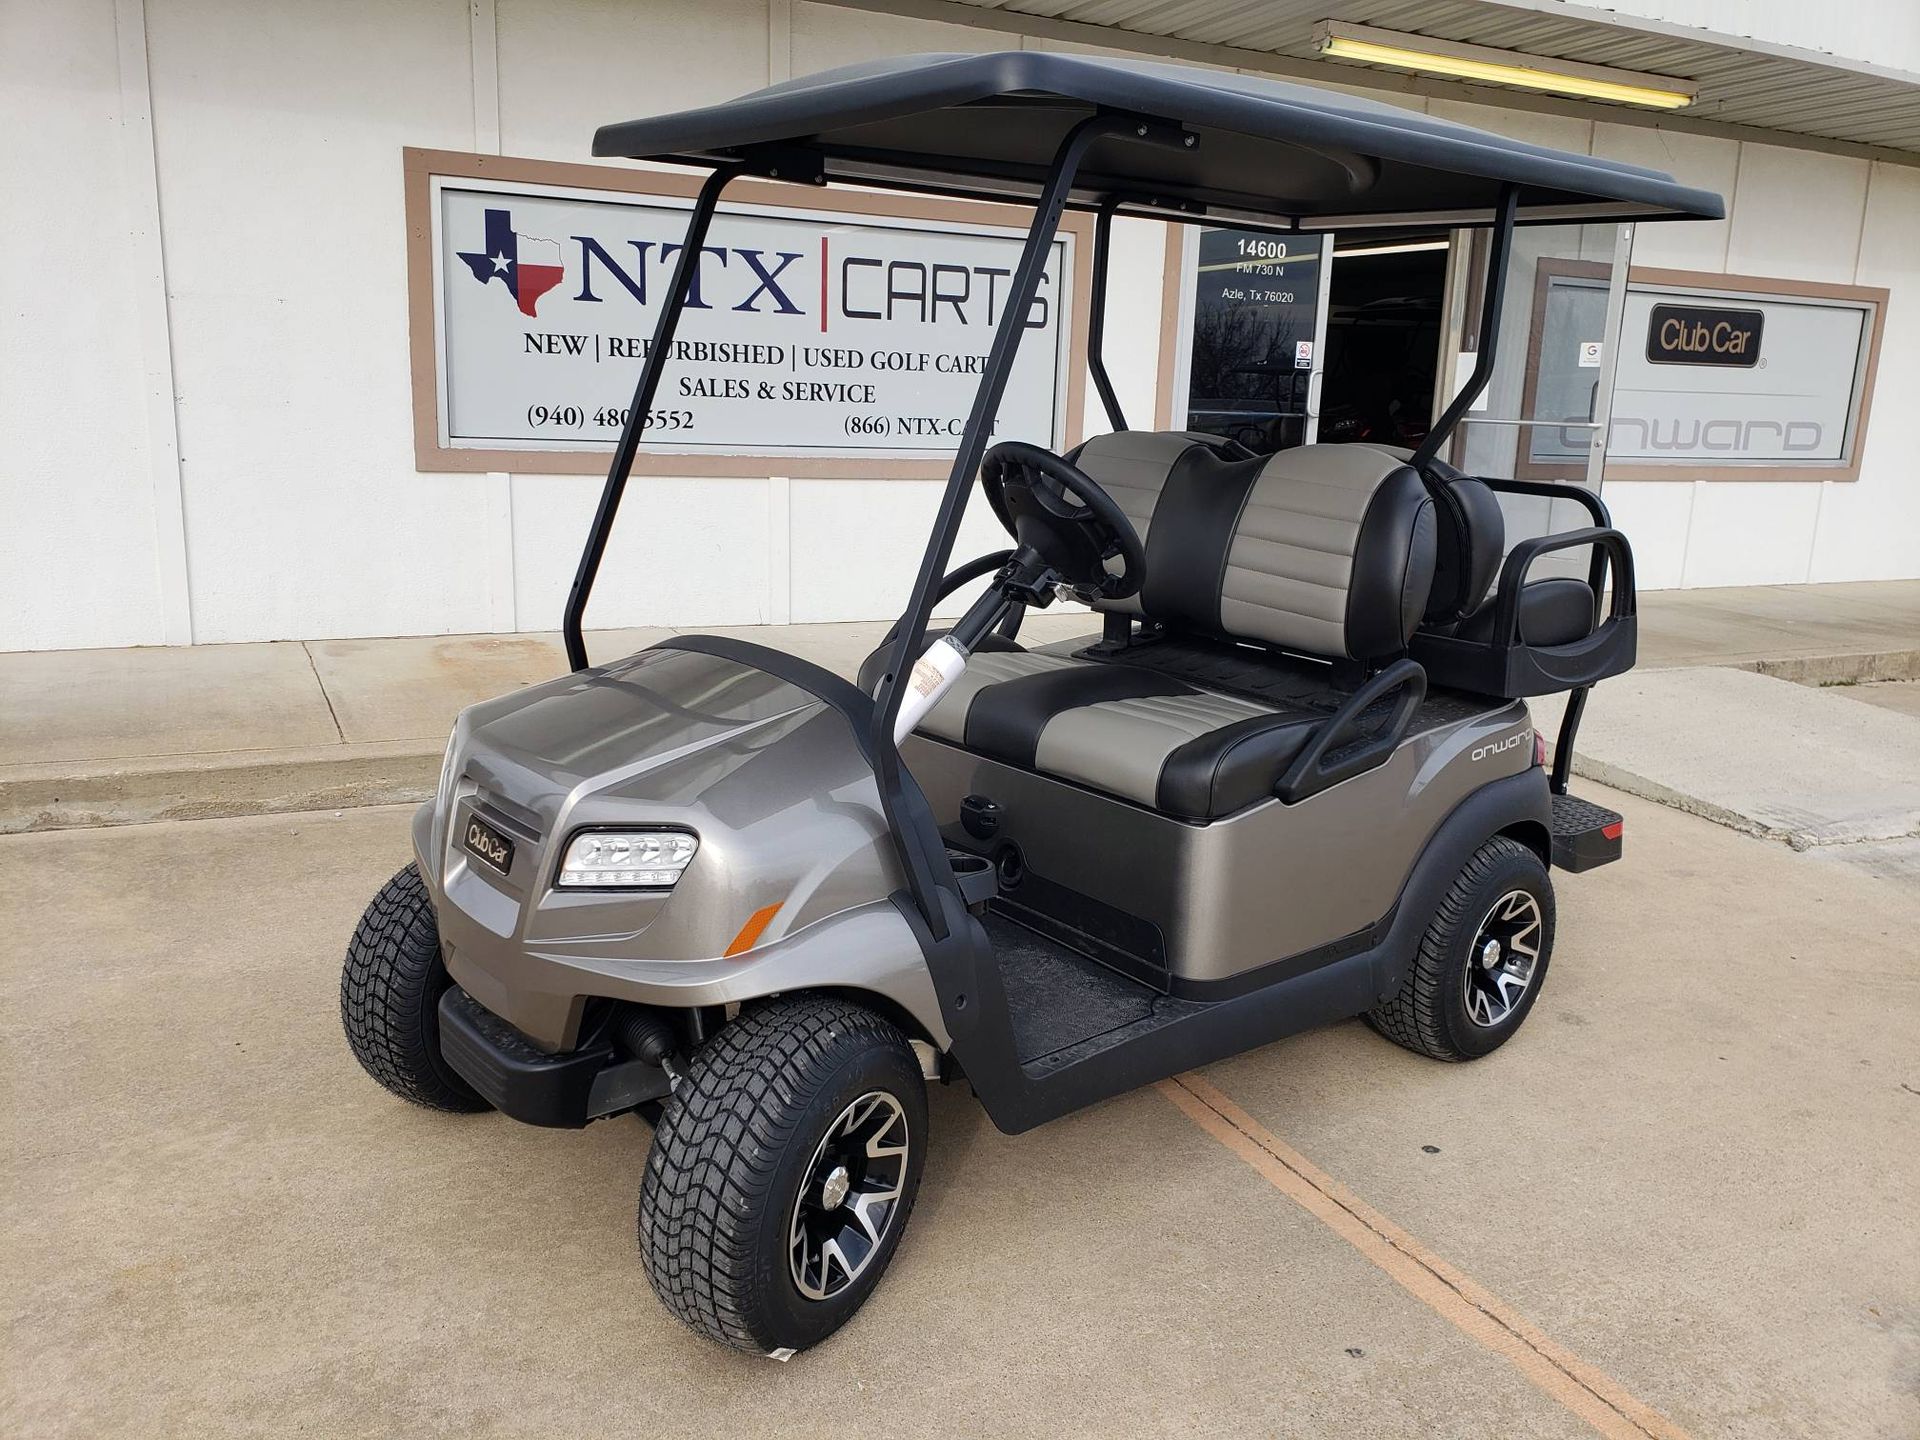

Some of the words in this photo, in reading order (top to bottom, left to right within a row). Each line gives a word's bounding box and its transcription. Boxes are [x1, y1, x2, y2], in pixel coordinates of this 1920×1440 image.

[1237, 239, 1287, 259] 14600
[570, 235, 806, 315] NTX
[1236, 263, 1253, 274] FM
[1255, 265, 1274, 276] 730
[1276, 266, 1284, 277] N
[1222, 287, 1246, 301] Azle,
[1250, 289, 1262, 301] Tx
[1264, 290, 1294, 303] 76020
[1660, 318, 1711, 353] Club
[1712, 321, 1751, 354] Car
[524, 332, 589, 356] NEW
[803, 347, 864, 369] USED
[870, 351, 931, 371] GOLF
[679, 376, 750, 399] SALES
[757, 381, 776, 400] &
[782, 381, 876, 404] SERVICE
[527, 404, 585, 430] (940)
[593, 406, 694, 430] 4805552
[844, 415, 891, 438] (866)
[897, 417, 1000, 437] NTX-CT
[1472, 728, 1532, 761] onward
[469, 824, 488, 852] Club
[489, 838, 507, 864] Car
